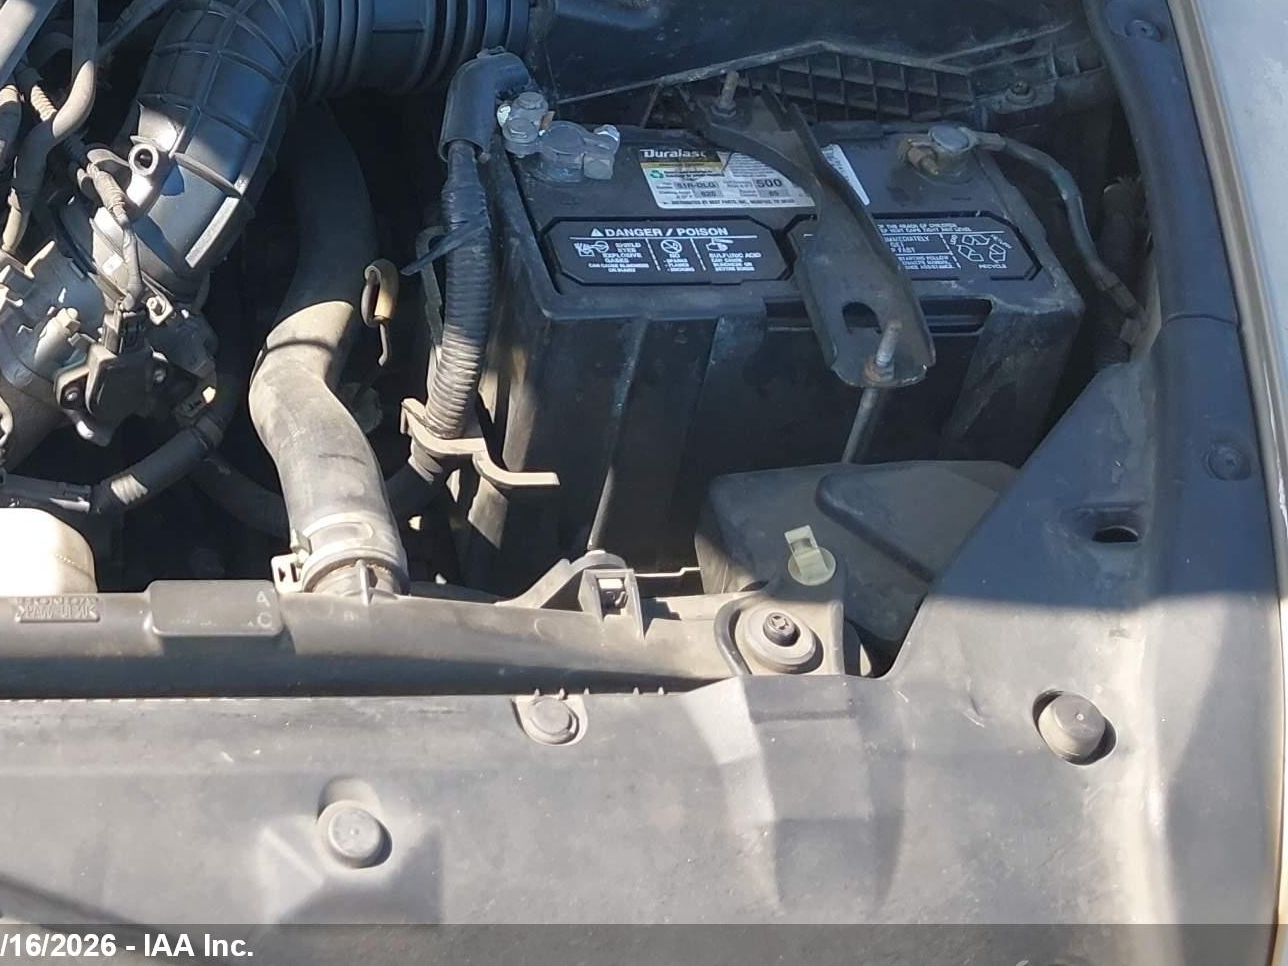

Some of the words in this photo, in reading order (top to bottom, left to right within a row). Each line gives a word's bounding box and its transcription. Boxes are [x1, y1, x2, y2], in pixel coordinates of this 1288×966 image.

[639, 149, 707, 158] Duralast
[756, 178, 782, 187] 500
[604, 228, 662, 237] DANGER
[676, 227, 729, 236] POISON
